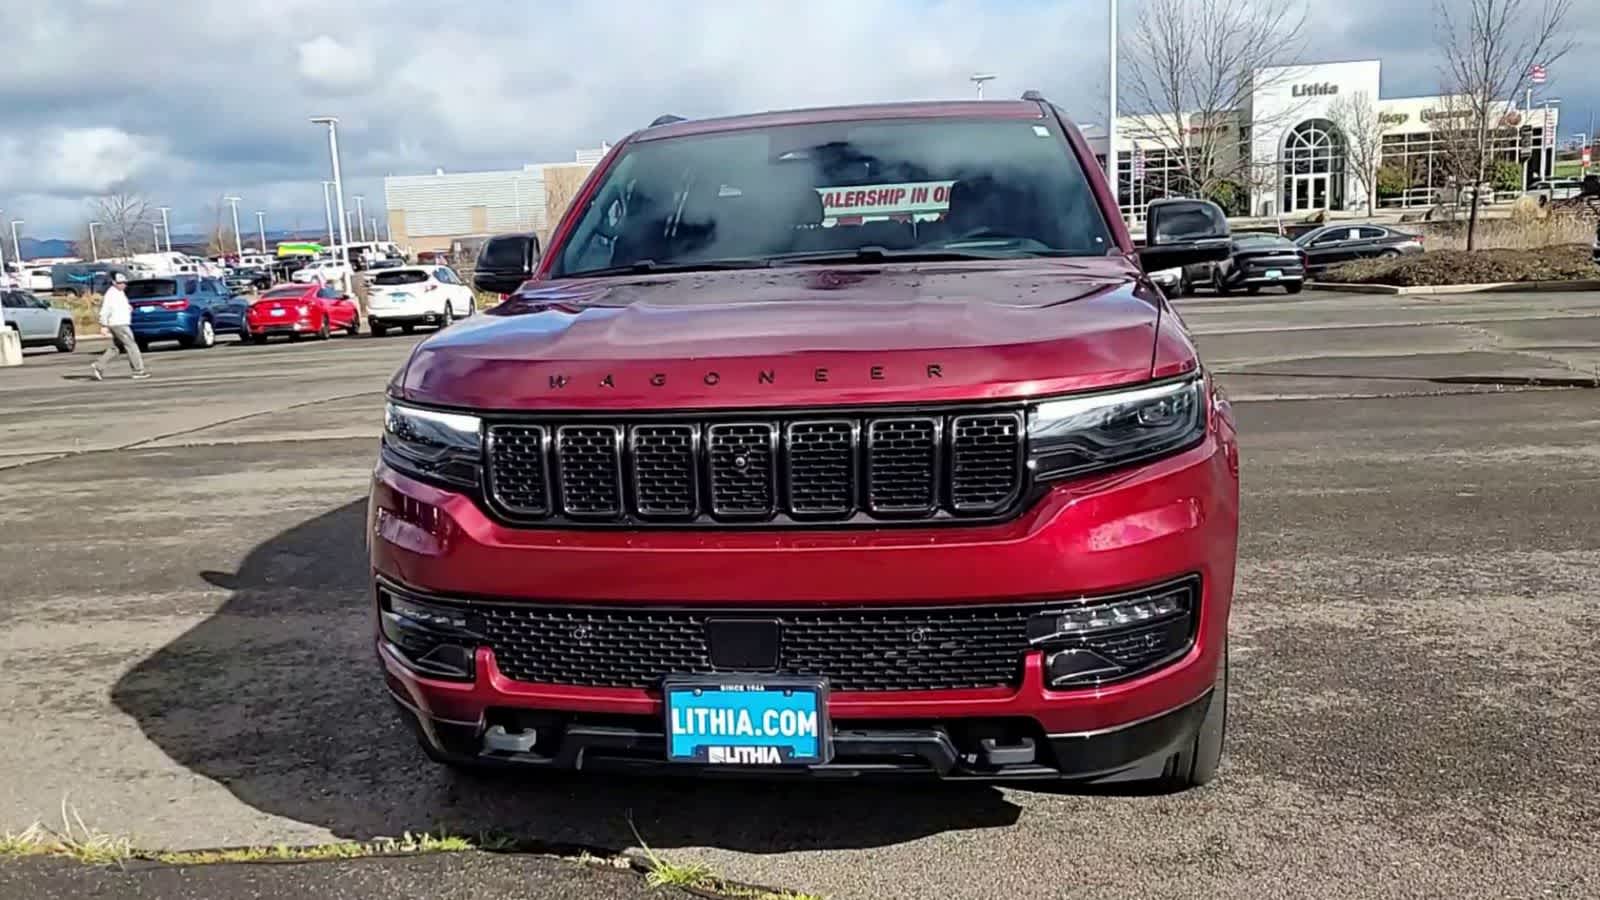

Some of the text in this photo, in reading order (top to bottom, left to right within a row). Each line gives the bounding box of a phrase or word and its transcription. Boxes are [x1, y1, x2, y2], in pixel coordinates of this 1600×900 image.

[1291, 81, 1338, 97] Lithia
[910, 187, 929, 204] IN
[549, 364, 942, 389] WAGONEER
[720, 684, 745, 692] SINCE
[671, 707, 818, 737] LITHIA.COM
[725, 747, 782, 764] LITHIA
